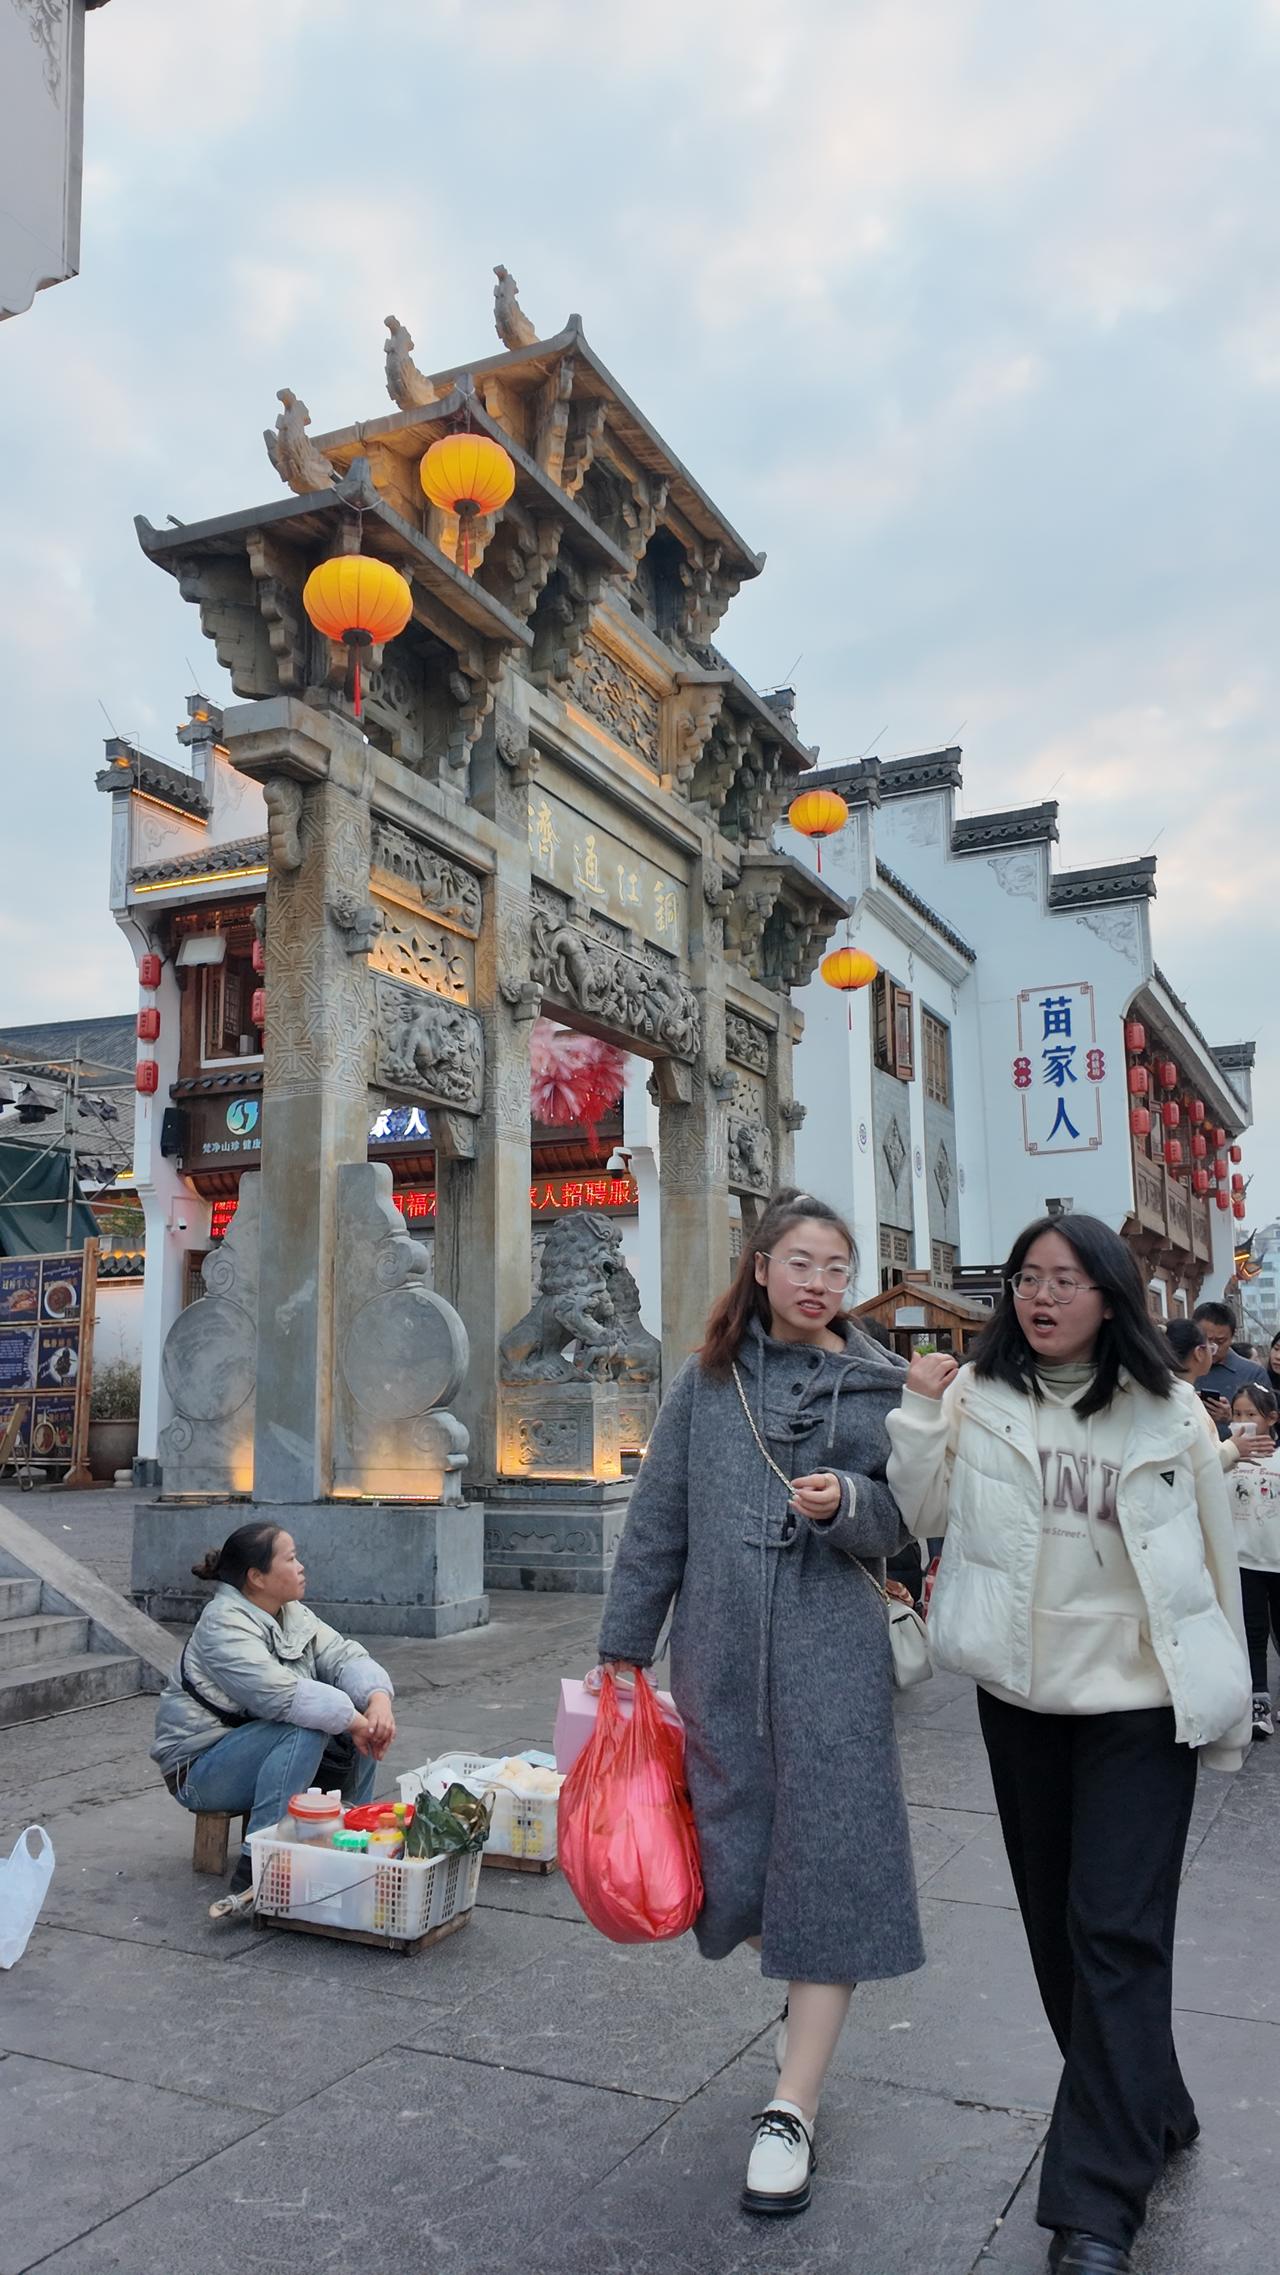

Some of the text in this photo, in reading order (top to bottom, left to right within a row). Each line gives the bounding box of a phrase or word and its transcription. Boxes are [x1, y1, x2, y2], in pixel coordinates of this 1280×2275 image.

[1039, 996, 1080, 1142] 苗家人
[528, 1180, 639, 1209] 人招聘服
[1051, 1527, 1081, 1539] Street
